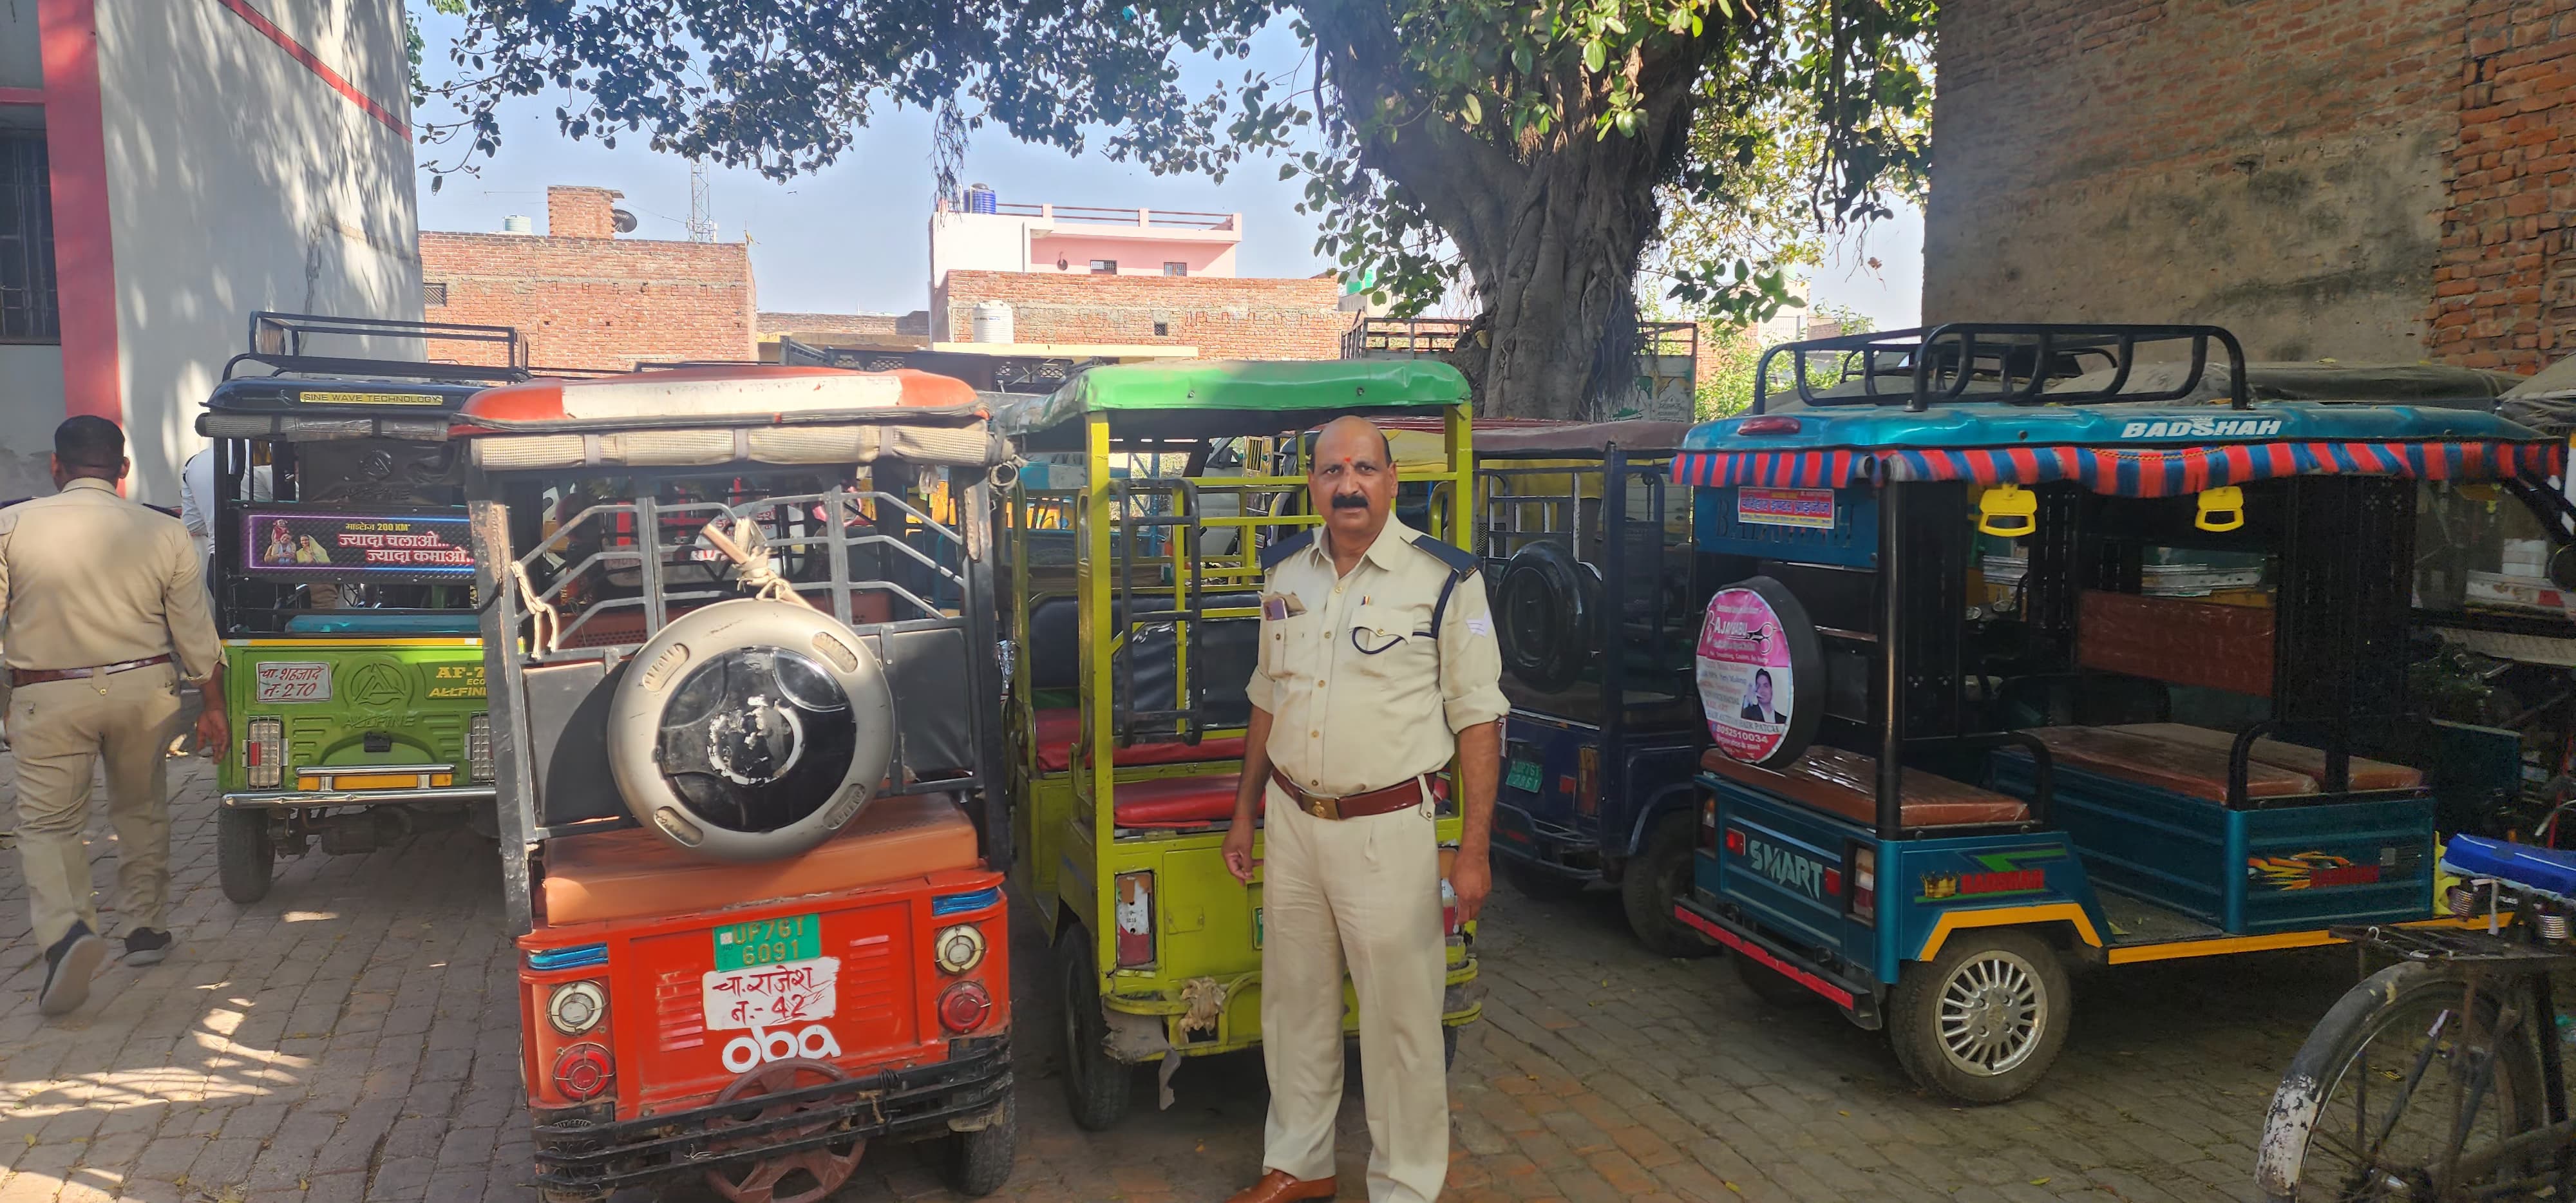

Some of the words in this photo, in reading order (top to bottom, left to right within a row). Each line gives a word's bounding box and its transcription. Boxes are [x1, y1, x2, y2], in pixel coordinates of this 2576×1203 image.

[367, 395, 438, 403] TECHNOLOGY
[2121, 420, 2282, 439] BADSHAH
[339, 534, 383, 547] ज्यादा
[367, 549, 410, 562] ज्यादा
[282, 683, 317, 697] 270
[429, 687, 488, 697] ALLFIN
[1750, 840, 1823, 901] SMART
[743, 939, 799, 966] 6091
[772, 994, 808, 1020] 42
[722, 1024, 842, 1074] oba
